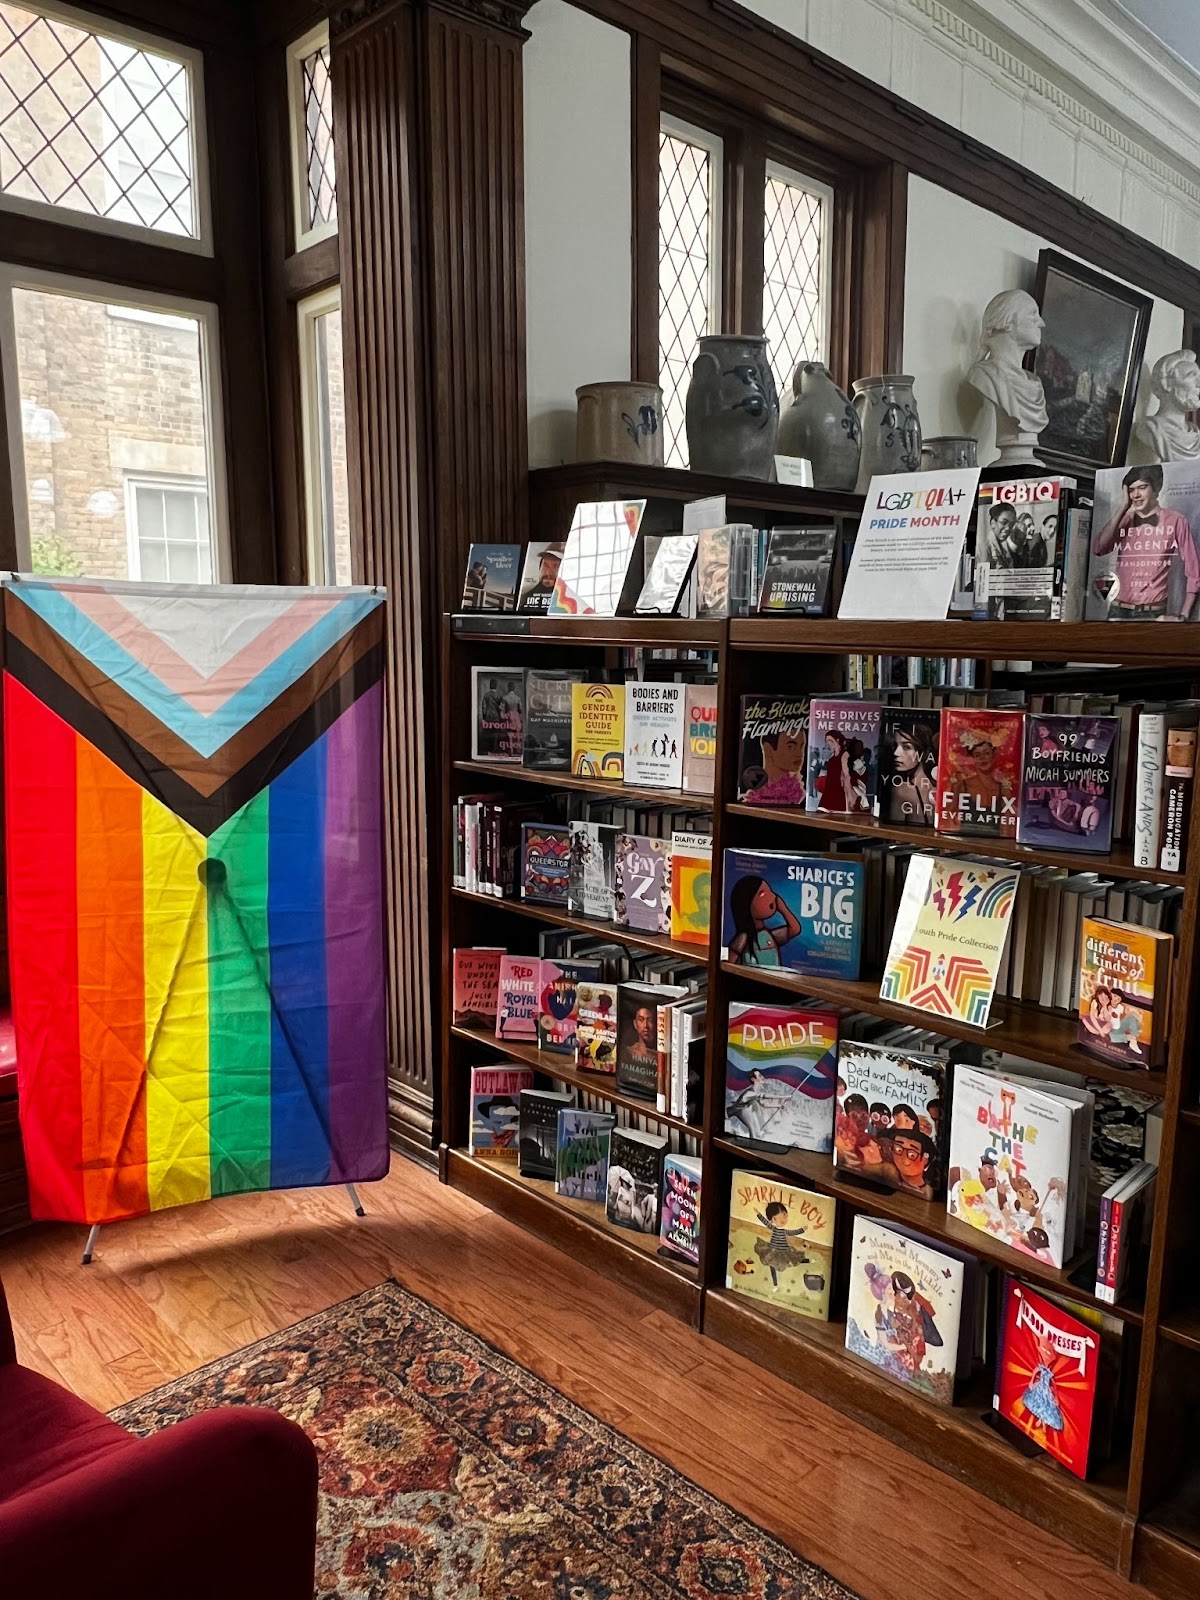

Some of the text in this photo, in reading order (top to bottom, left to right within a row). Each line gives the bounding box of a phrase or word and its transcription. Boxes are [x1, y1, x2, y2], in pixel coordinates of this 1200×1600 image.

[876, 486, 966, 511] LGBTQIA+
[992, 481, 1054, 504] LGBTQ
[869, 515, 961, 530] PRIDE MONTH
[1119, 525, 1175, 538] BEYOND
[1113, 539, 1179, 552] MAGENTA
[771, 582, 817, 592] STONEWALL
[769, 591, 815, 603] UPRISING
[530, 694, 572, 711] CIT
[632, 687, 679, 700] BODIES AND
[579, 711, 618, 721] IDENTITY
[581, 703, 616, 712] GENDER
[636, 701, 674, 714] BARRIERS
[744, 698, 811, 720] the Black
[814, 709, 836, 720] SHE
[839, 710, 880, 721] DRIVES
[585, 721, 612, 730] GUIDE
[817, 721, 877, 732] ME CRAZY
[885, 722, 900, 734] IF
[1058, 733, 1078, 747] 99
[1031, 747, 1106, 765] BOYFRIENDS
[881, 774, 930, 789] YOUR
[1025, 765, 1110, 783] MICAH SUMMERS
[901, 801, 934, 816] GIR
[941, 791, 1017, 815] FELIX
[941, 811, 1016, 826] EVER AFTER
[1165, 788, 1177, 849] CAMERON POS
[674, 835, 696, 845] DIARY
[697, 837, 708, 845] OF
[787, 865, 856, 887] SHARICE'S
[630, 874, 658, 908] Z
[800, 882, 855, 924] BIG
[813, 920, 853, 939] VOICE
[915, 926, 999, 952] outh Pride Collection
[1086, 937, 1146, 968] different
[467, 970, 495, 979] UNDER
[511, 965, 534, 979] RED
[1092, 952, 1142, 980] kinds of
[462, 981, 478, 989] THE
[501, 979, 535, 992] WHITE
[1096, 966, 1139, 995] fruit
[503, 992, 539, 1006] ROYAL
[502, 1005, 534, 1019] BLUE
[742, 1021, 825, 1049] PRIDE
[846, 1061, 929, 1095] Dad and Daddy's
[847, 1075, 928, 1108] BIG BIG FAMILY
[977, 1104, 1039, 1145] BATHE
[988, 1130, 1024, 1160] THE
[984, 1147, 1027, 1177] CAT
[673, 1180, 697, 1200] SEVEN
[737, 1184, 797, 1210] SPARKLE
[670, 1190, 700, 1215] MOONS
[680, 1209, 690, 1219] OF
[800, 1199, 828, 1230] BOY
[672, 1218, 696, 1238] MAALI
[869, 1237, 894, 1250] Mama
[908, 1248, 941, 1281] Mommy
[878, 1249, 893, 1261] Me
[914, 1265, 944, 1297] Middle
[1047, 1329, 1082, 1352] DRESSES
